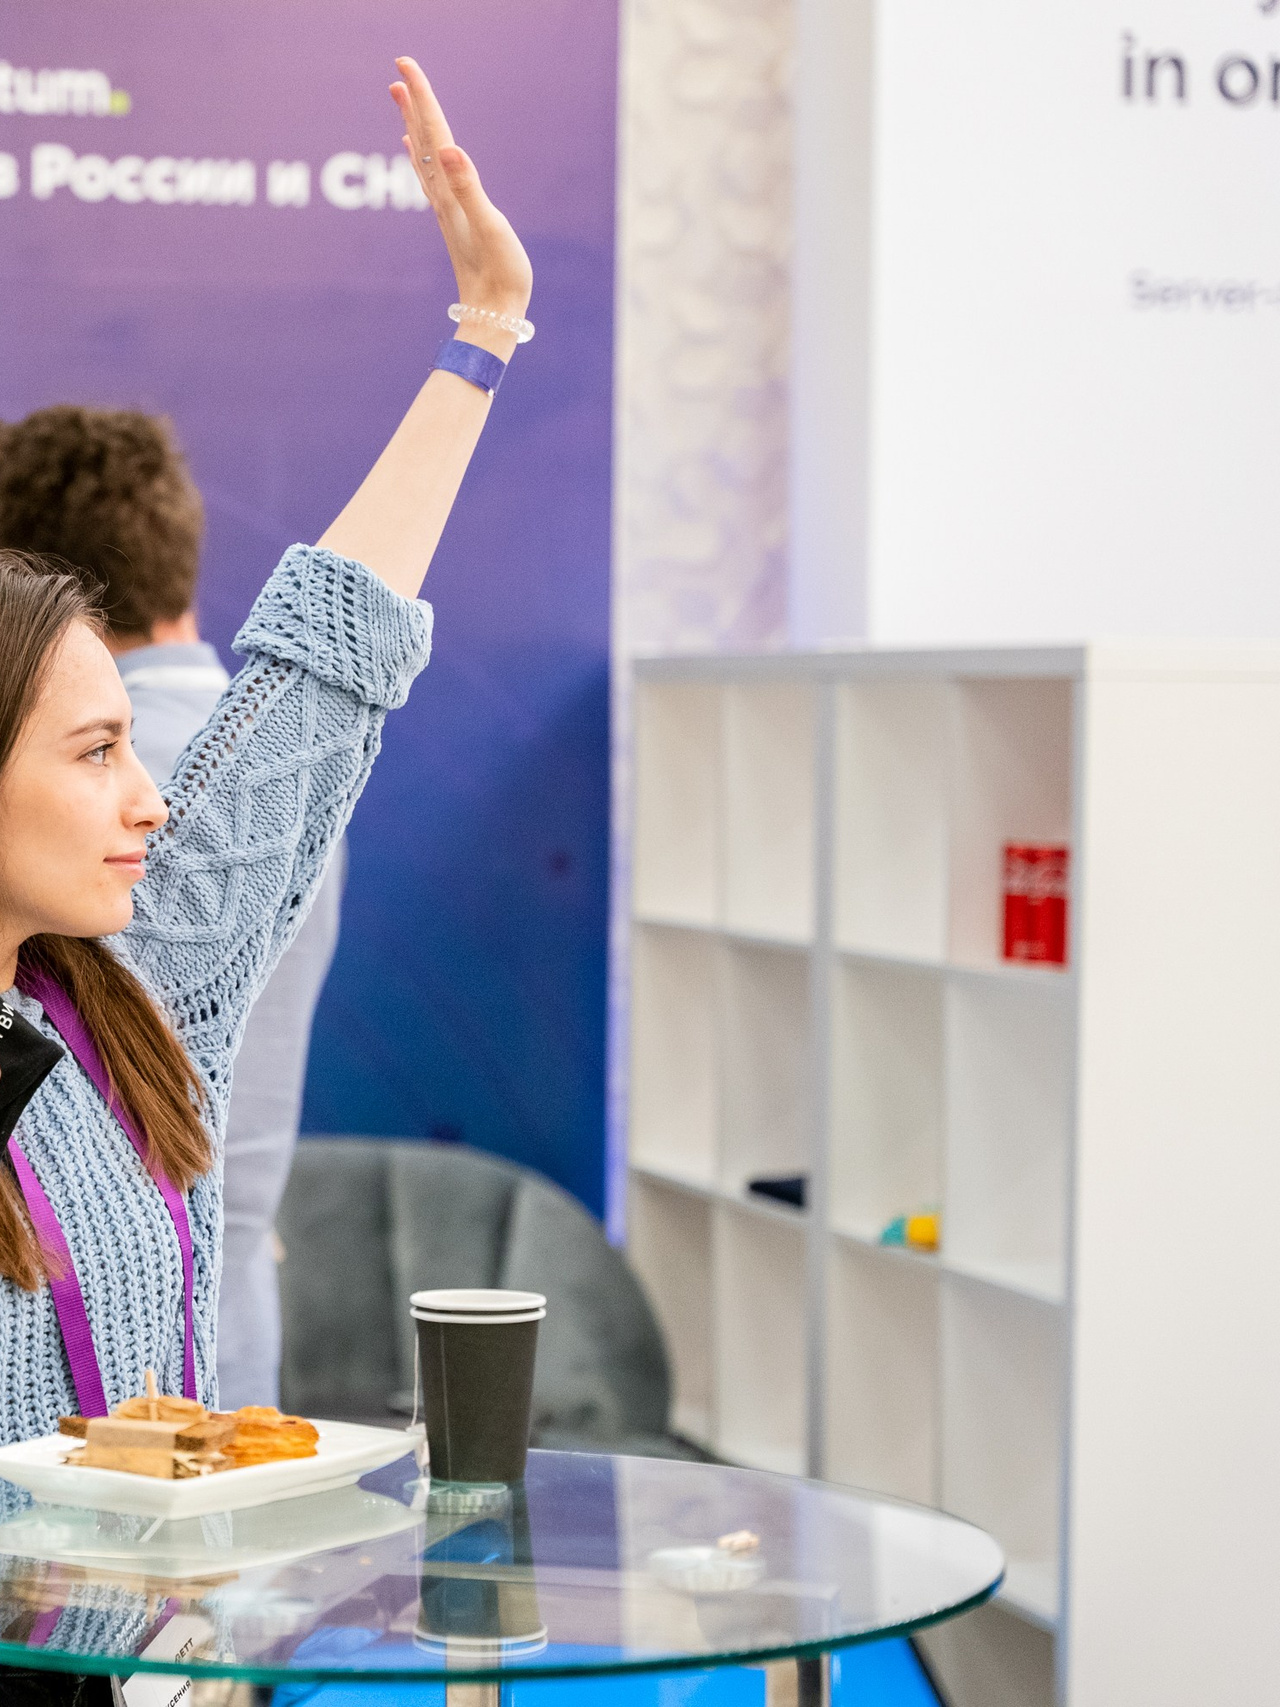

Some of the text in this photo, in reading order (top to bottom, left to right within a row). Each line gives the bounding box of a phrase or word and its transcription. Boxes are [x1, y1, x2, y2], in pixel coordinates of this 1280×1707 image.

[1122, 32, 1187, 100] in
[30, 142, 257, 207] России
[266, 160, 312, 209] и
[1128, 268, 1280, 312] Server-
